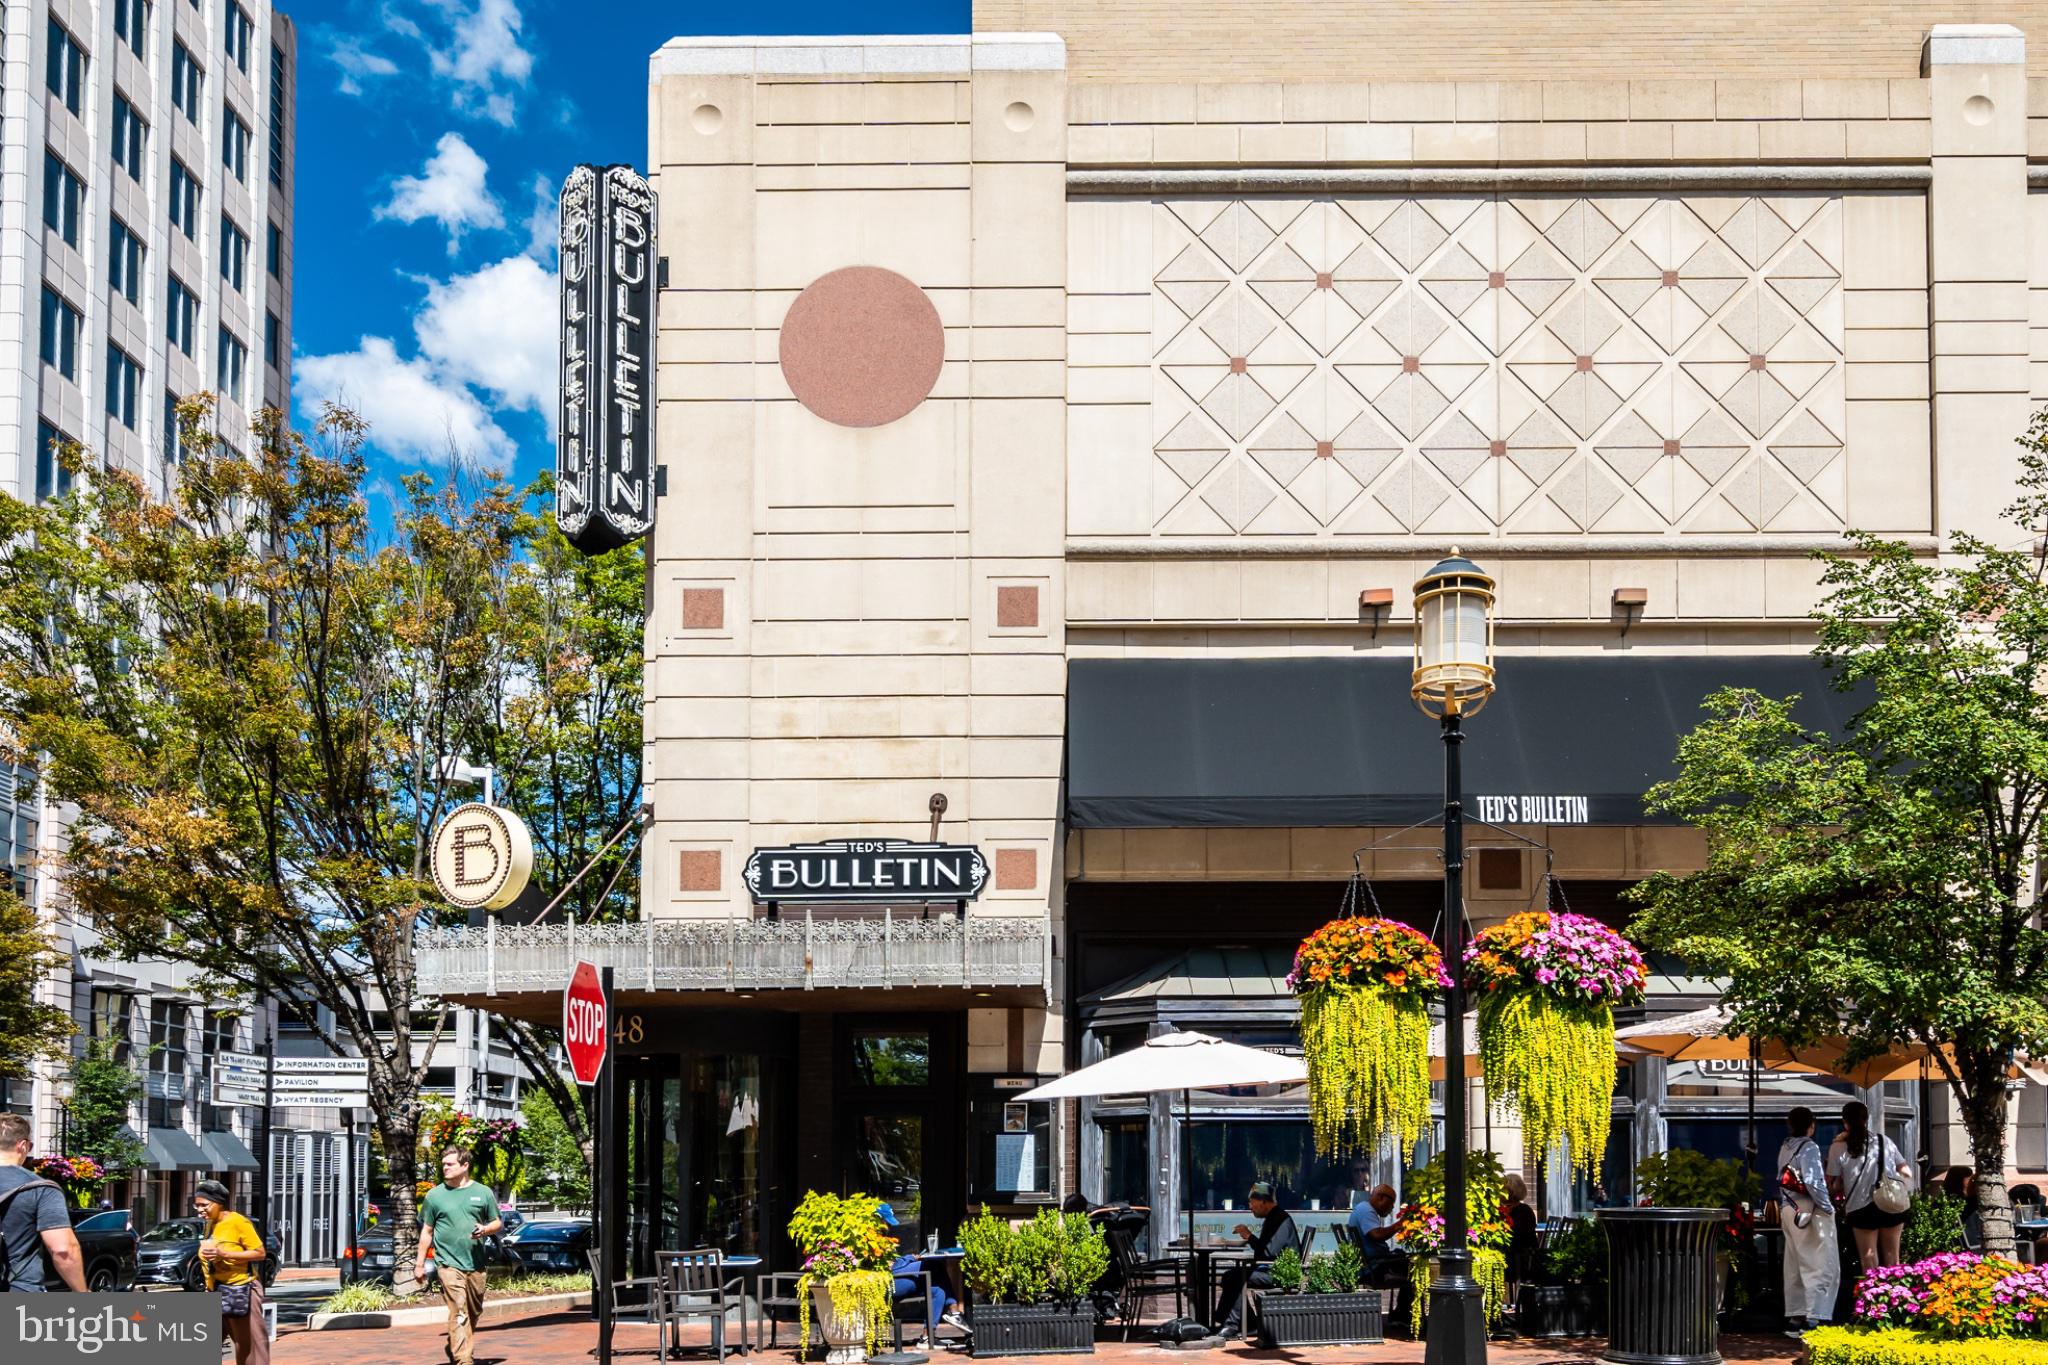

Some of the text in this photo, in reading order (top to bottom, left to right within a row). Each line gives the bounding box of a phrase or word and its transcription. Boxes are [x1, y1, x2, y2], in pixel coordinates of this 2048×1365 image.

[562, 206, 589, 512] BULLETIN
[611, 205, 646, 514] BULLETIN
[1476, 796, 1588, 823] TED'S BULLETIN
[450, 824, 499, 888] B
[848, 841, 885, 853] TED'S
[770, 857, 961, 888] BULLETIN
[568, 997, 604, 1047] STOP
[284, 1060, 366, 1069] INFORMATION CENTER
